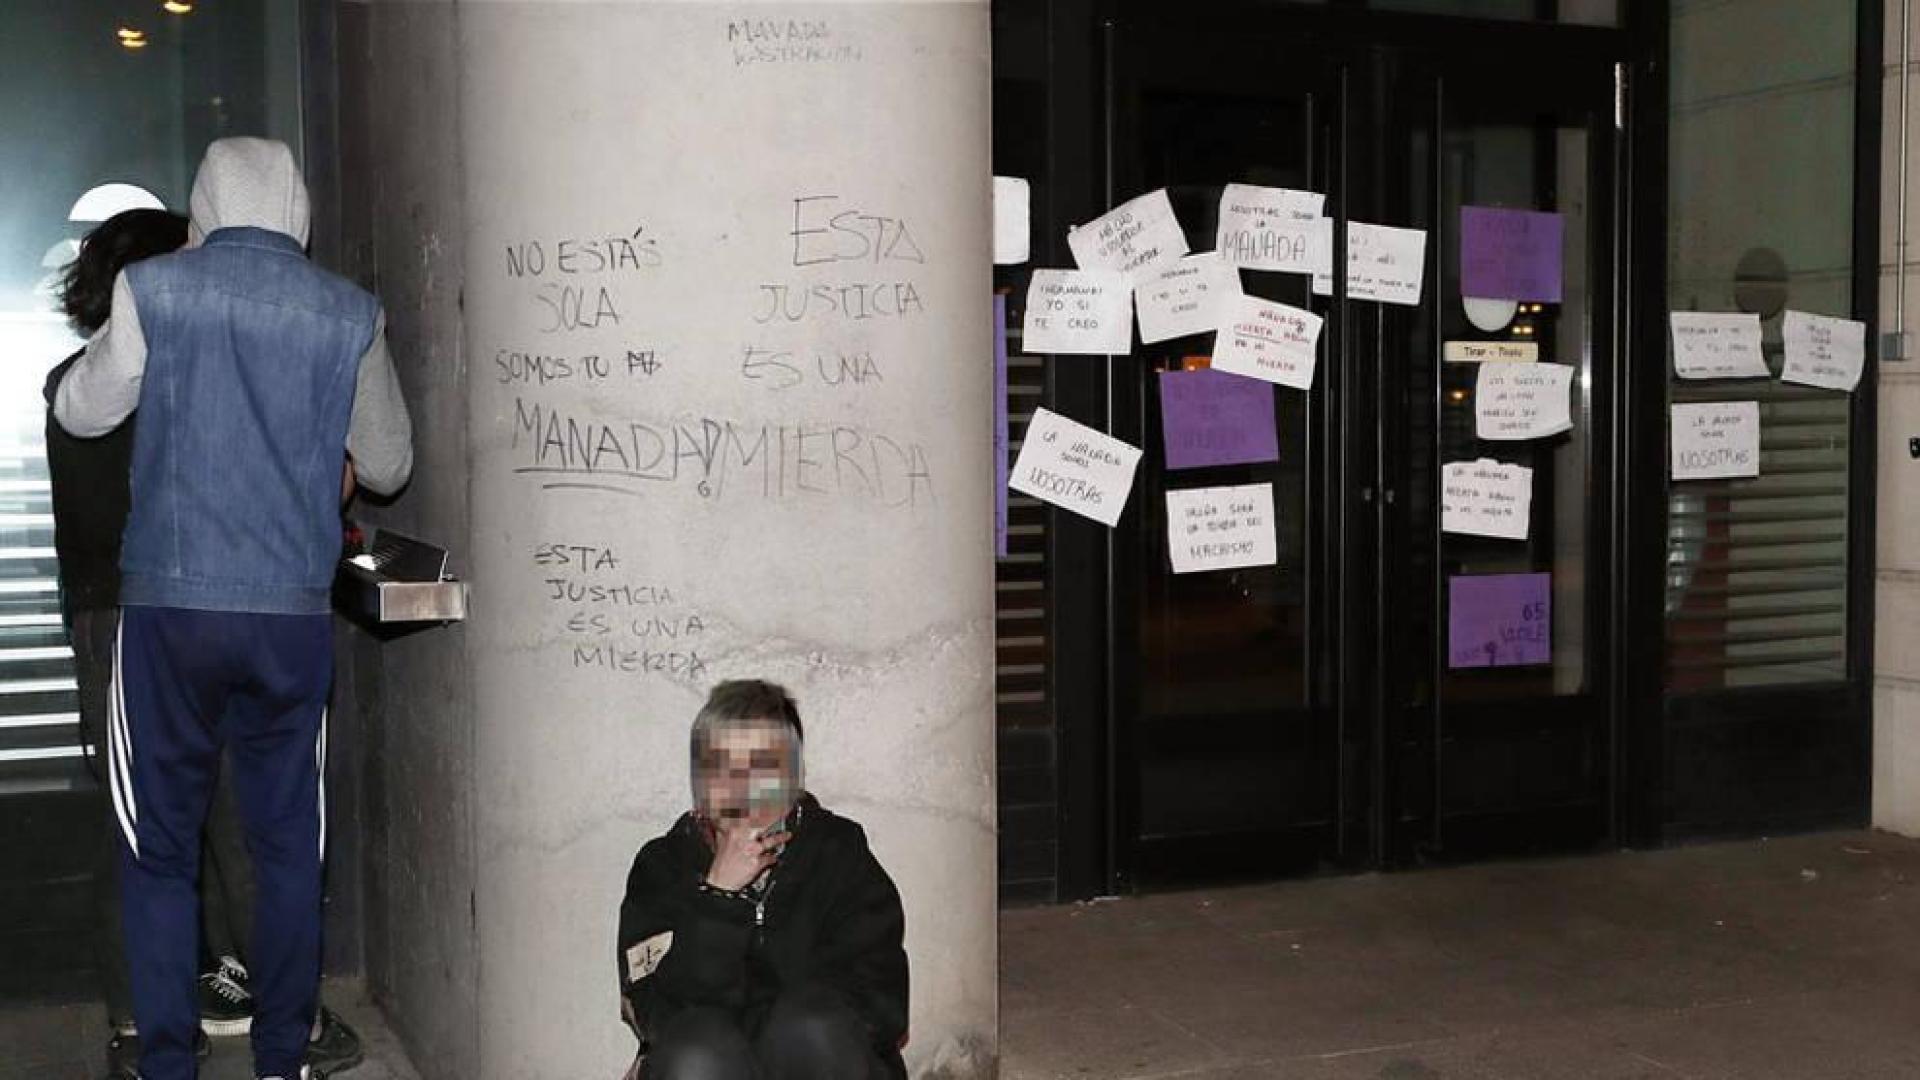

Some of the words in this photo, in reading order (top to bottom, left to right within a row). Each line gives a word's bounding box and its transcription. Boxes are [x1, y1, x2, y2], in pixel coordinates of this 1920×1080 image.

[790, 195, 925, 267] ESTA
[1222, 228, 1307, 263] MANADA
[506, 241, 545, 278] NO
[558, 226, 662, 273] ESTÁS
[536, 283, 621, 333] SOLA
[755, 281, 924, 322] JUSTICIA
[1046, 300, 1064, 311] YO
[1034, 317, 1048, 330] TE
[1067, 317, 1099, 329] CREO
[496, 350, 573, 384] SOMOS
[583, 356, 610, 379] TU
[741, 346, 803, 389] ES
[818, 352, 882, 386] UNA
[716, 420, 938, 512] MIERDA
[1680, 448, 1750, 470] NOSOTRAS
[534, 544, 617, 573] ESTA
[545, 579, 675, 605] JUSTICIA
[566, 612, 610, 634] ES
[632, 615, 705, 638] UNA
[573, 647, 708, 680] MIERDA
